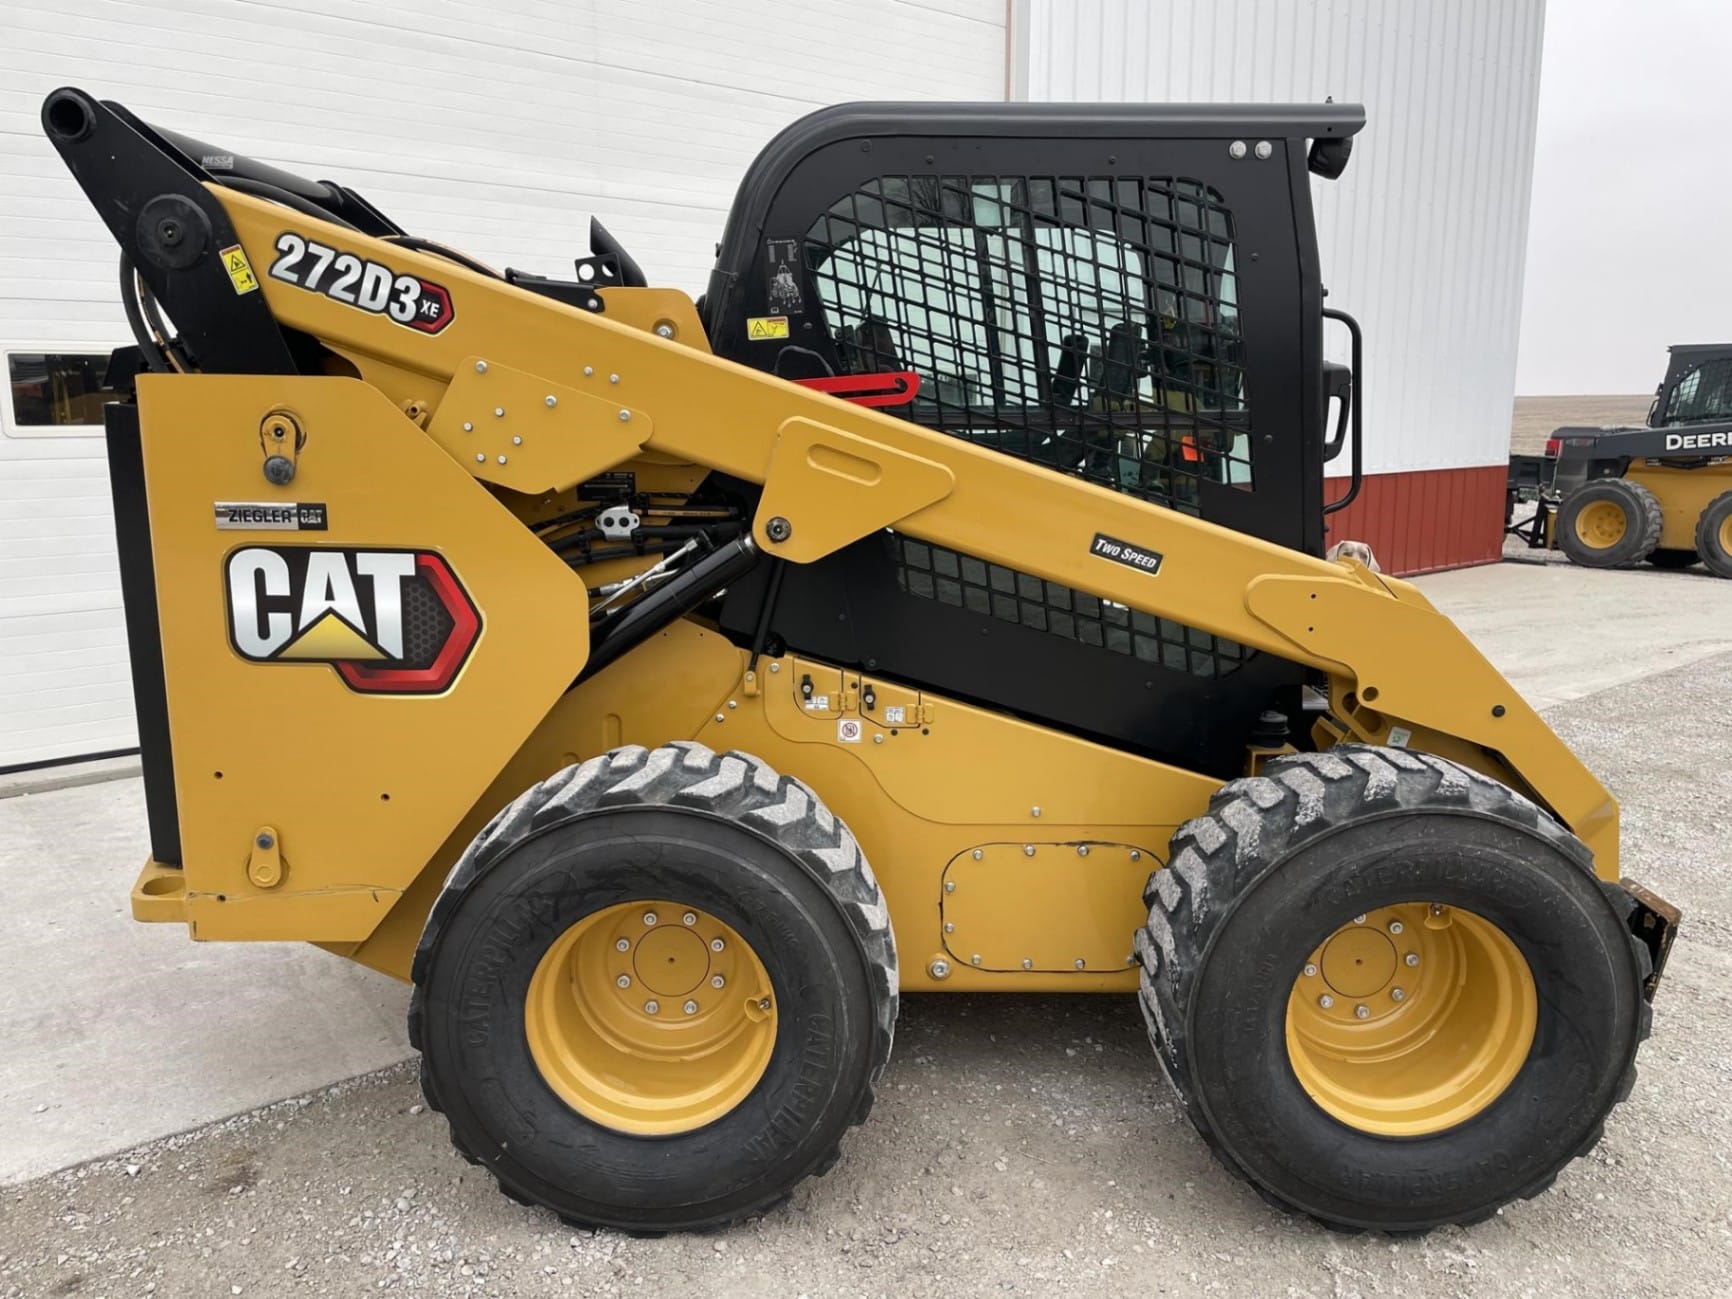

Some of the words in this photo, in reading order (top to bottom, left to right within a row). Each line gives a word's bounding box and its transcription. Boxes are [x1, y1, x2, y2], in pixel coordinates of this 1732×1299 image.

[271, 234, 422, 322] 272D3
[420, 299, 440, 318] XE
[228, 509, 292, 523] ZIEGLER
[300, 509, 323, 524] CAT
[229, 548, 416, 660] CAT
